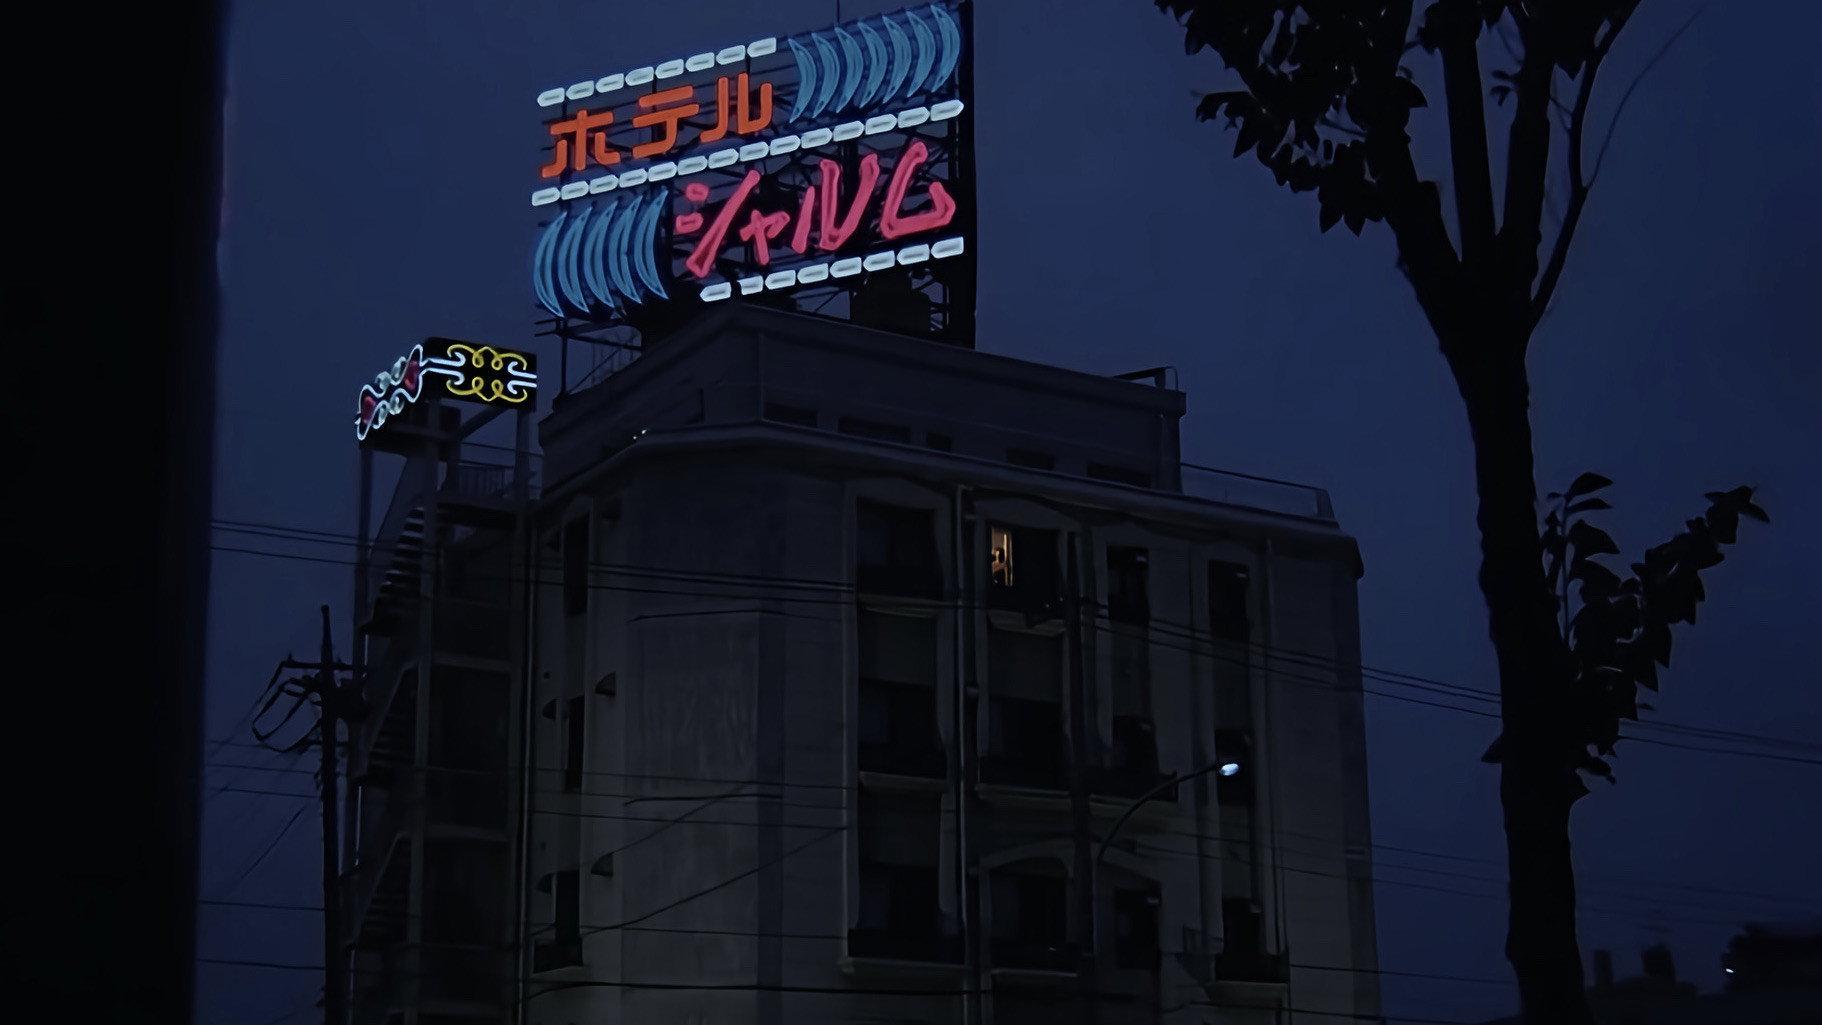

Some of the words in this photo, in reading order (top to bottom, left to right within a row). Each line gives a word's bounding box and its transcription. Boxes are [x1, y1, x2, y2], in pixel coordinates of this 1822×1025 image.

[541, 72, 772, 178] ホテル
[675, 141, 956, 278] シャルム
